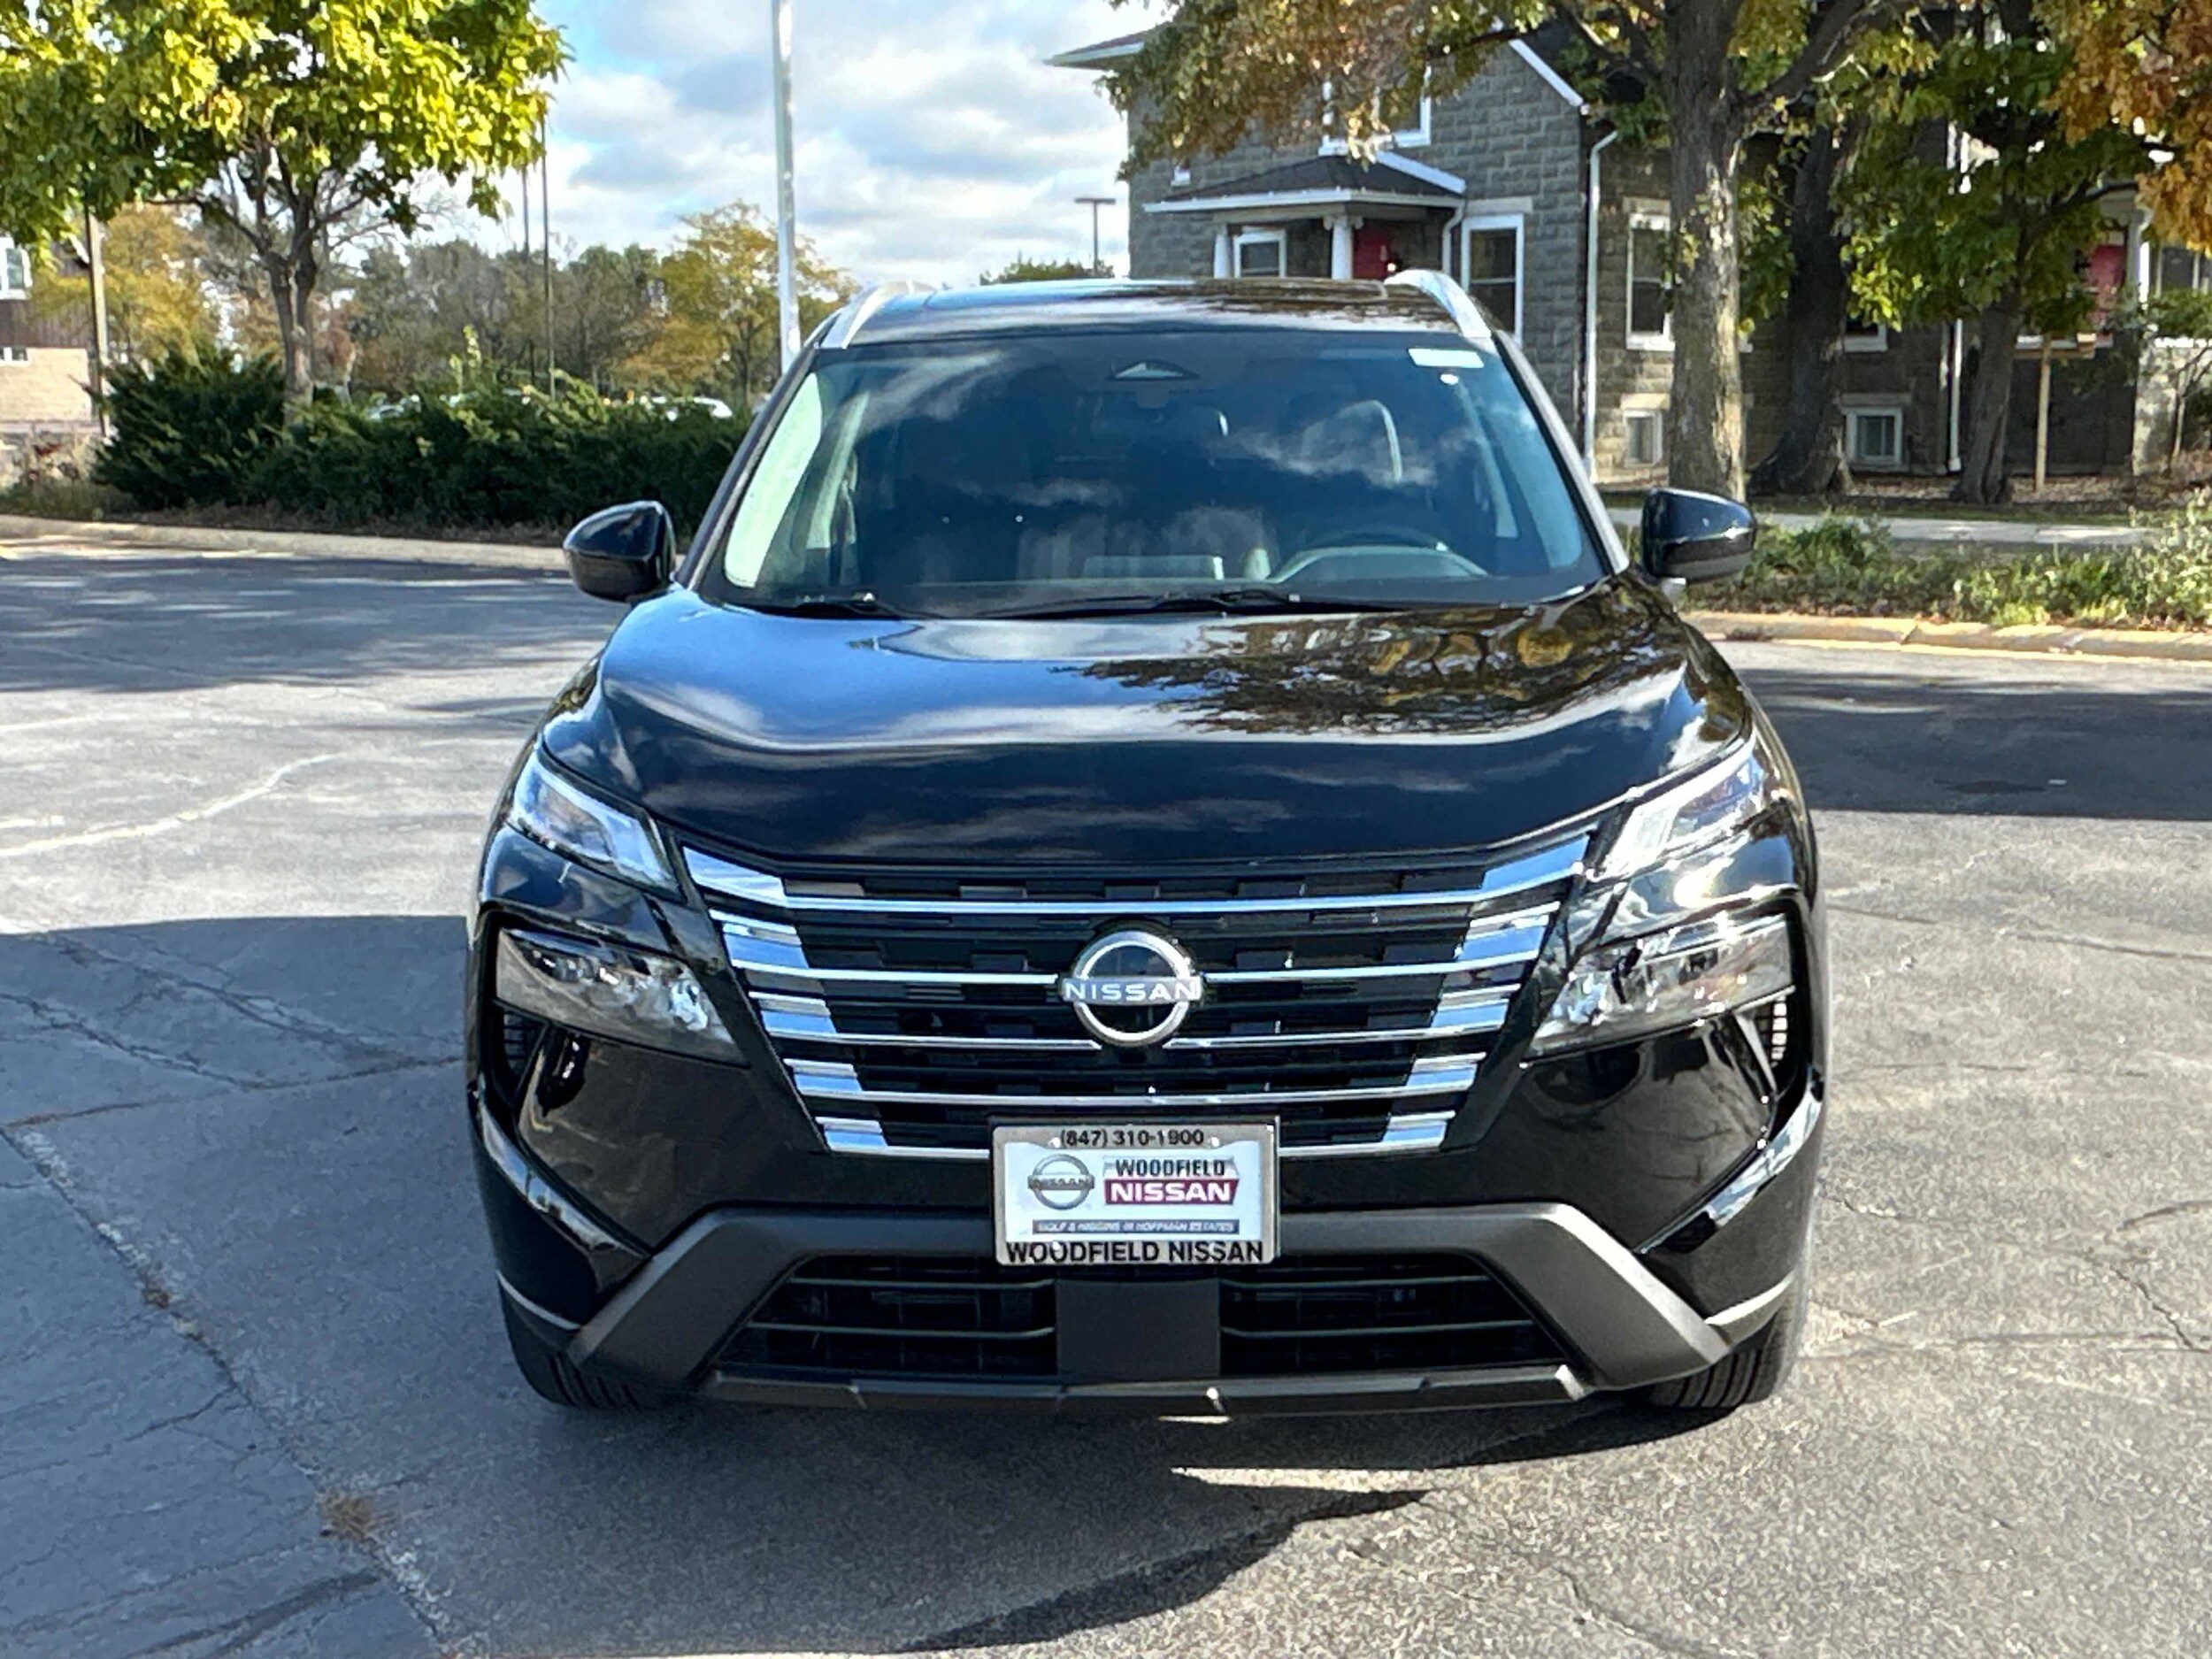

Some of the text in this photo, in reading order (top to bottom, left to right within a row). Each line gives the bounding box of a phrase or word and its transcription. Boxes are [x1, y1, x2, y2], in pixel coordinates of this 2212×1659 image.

[1065, 982, 1198, 1001] NISSAN
[1060, 1129, 1205, 1148] (847) 310-1900
[1115, 1158, 1225, 1177] WOODFIELD
[1110, 1182, 1231, 1202] NISSAN
[1007, 1240, 1263, 1263] WOODFIELD NISSAN
